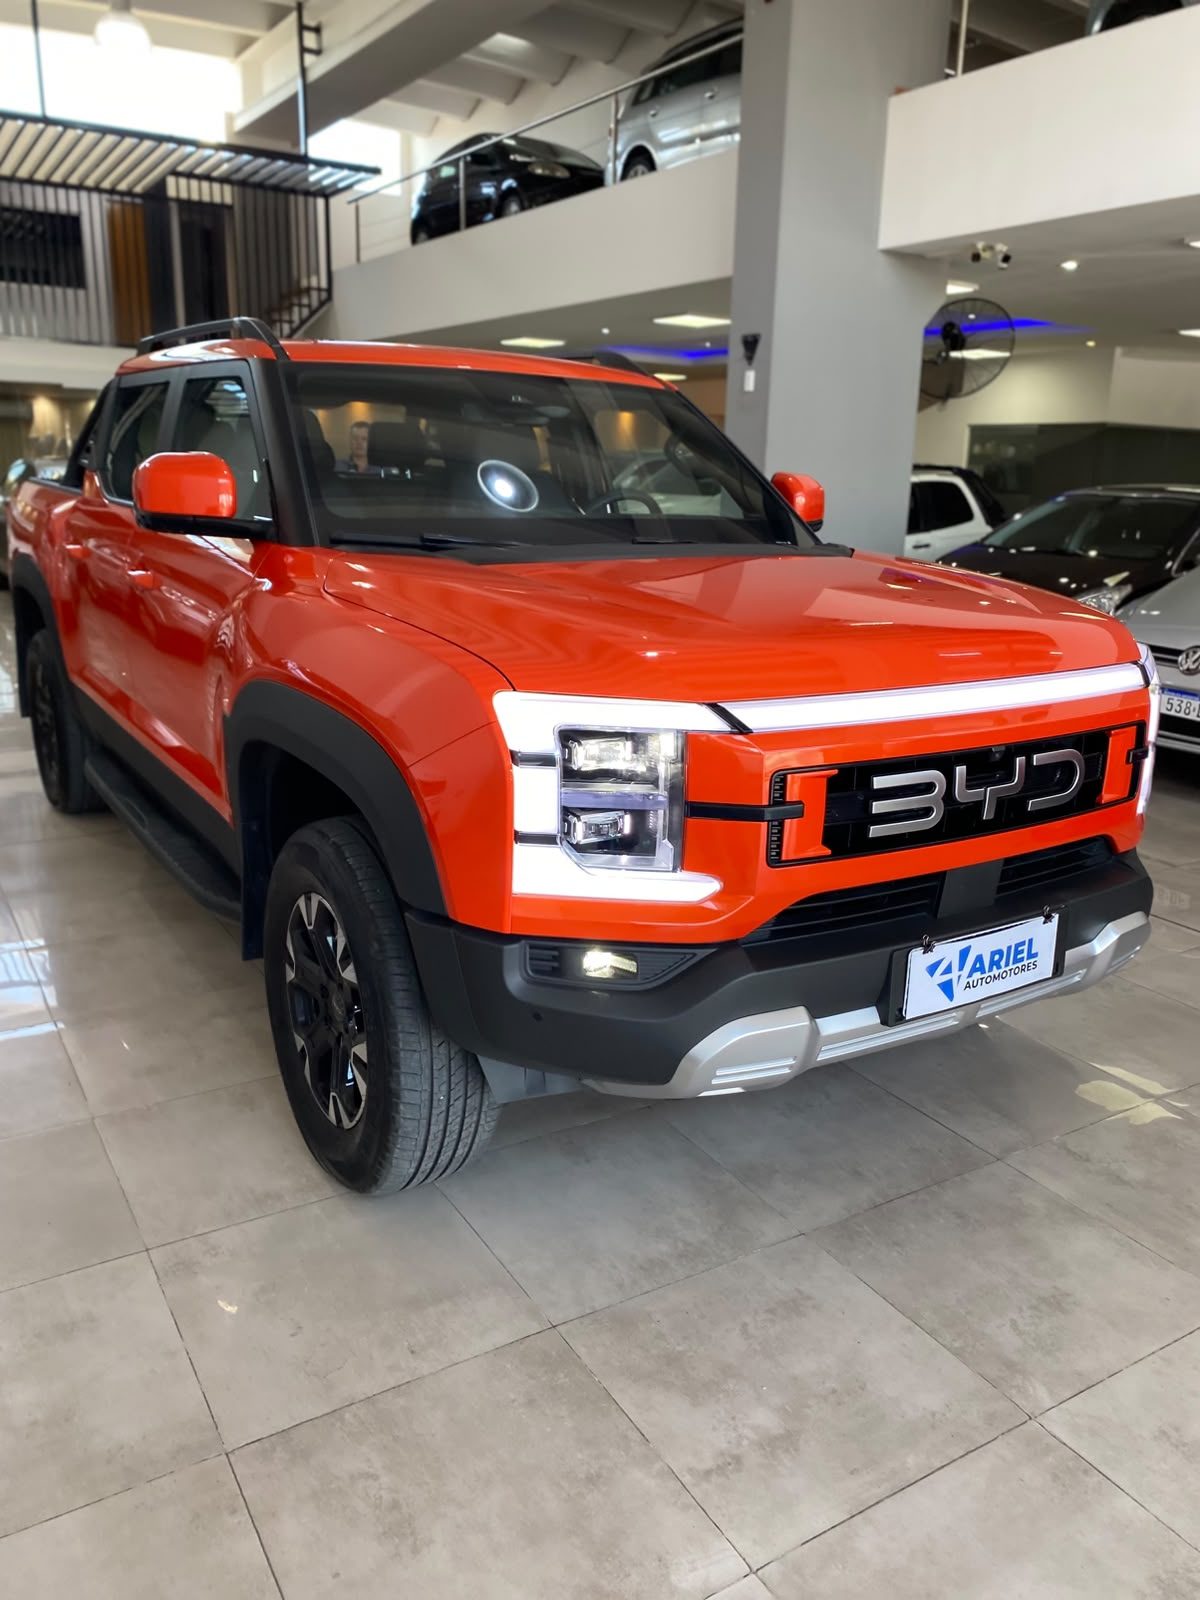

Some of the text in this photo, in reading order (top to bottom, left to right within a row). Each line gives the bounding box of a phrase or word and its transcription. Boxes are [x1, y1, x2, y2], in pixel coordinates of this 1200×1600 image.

[868, 748, 1085, 838] BYD
[963, 960, 1038, 991] AUTOMOTORES
[966, 937, 1039, 979] ARIEL
